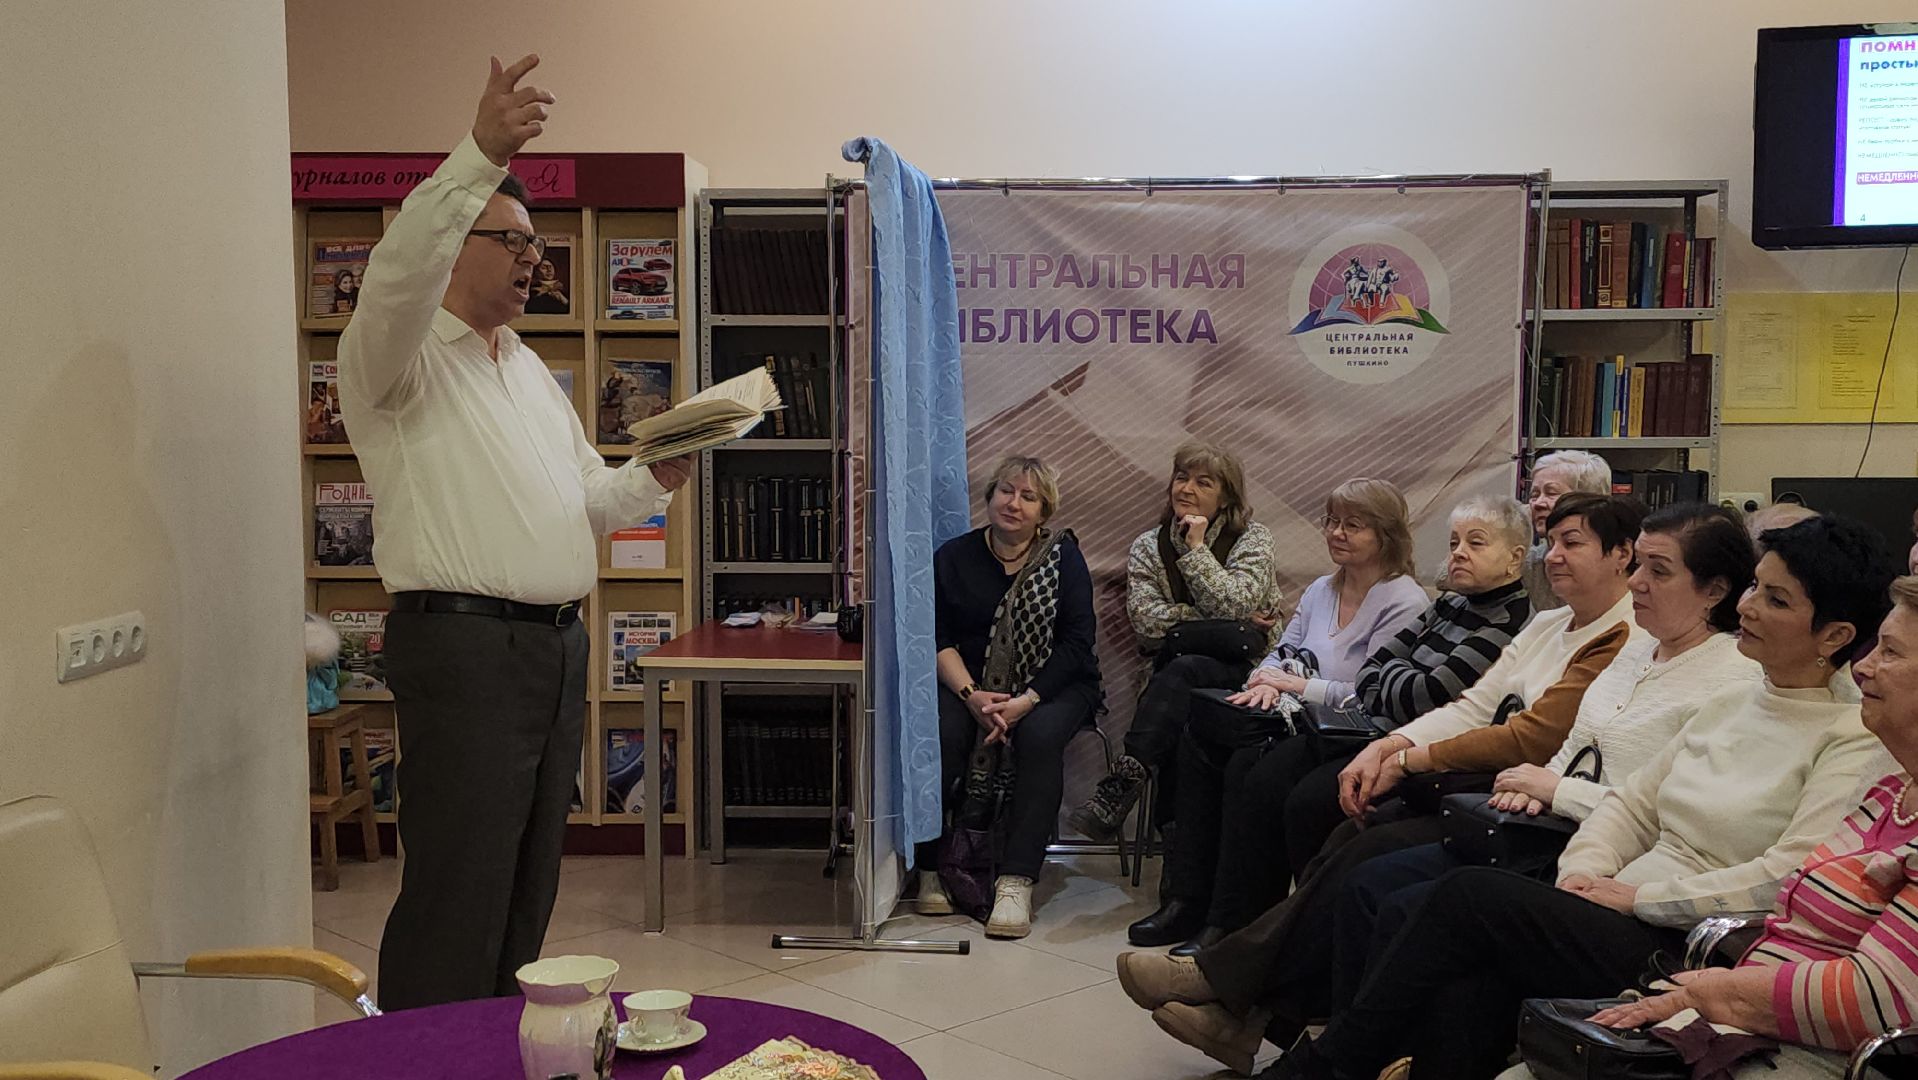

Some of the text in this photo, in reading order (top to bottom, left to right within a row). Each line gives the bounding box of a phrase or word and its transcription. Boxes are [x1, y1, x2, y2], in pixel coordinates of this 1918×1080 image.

[958, 308, 1218, 344] БЛИОТЕКА
[1326, 333, 1414, 343] ЦЕНТРАЛЬНАЯ
[1329, 346, 1409, 355] БИБЛИОТЕКА
[331, 612, 366, 623] САД
